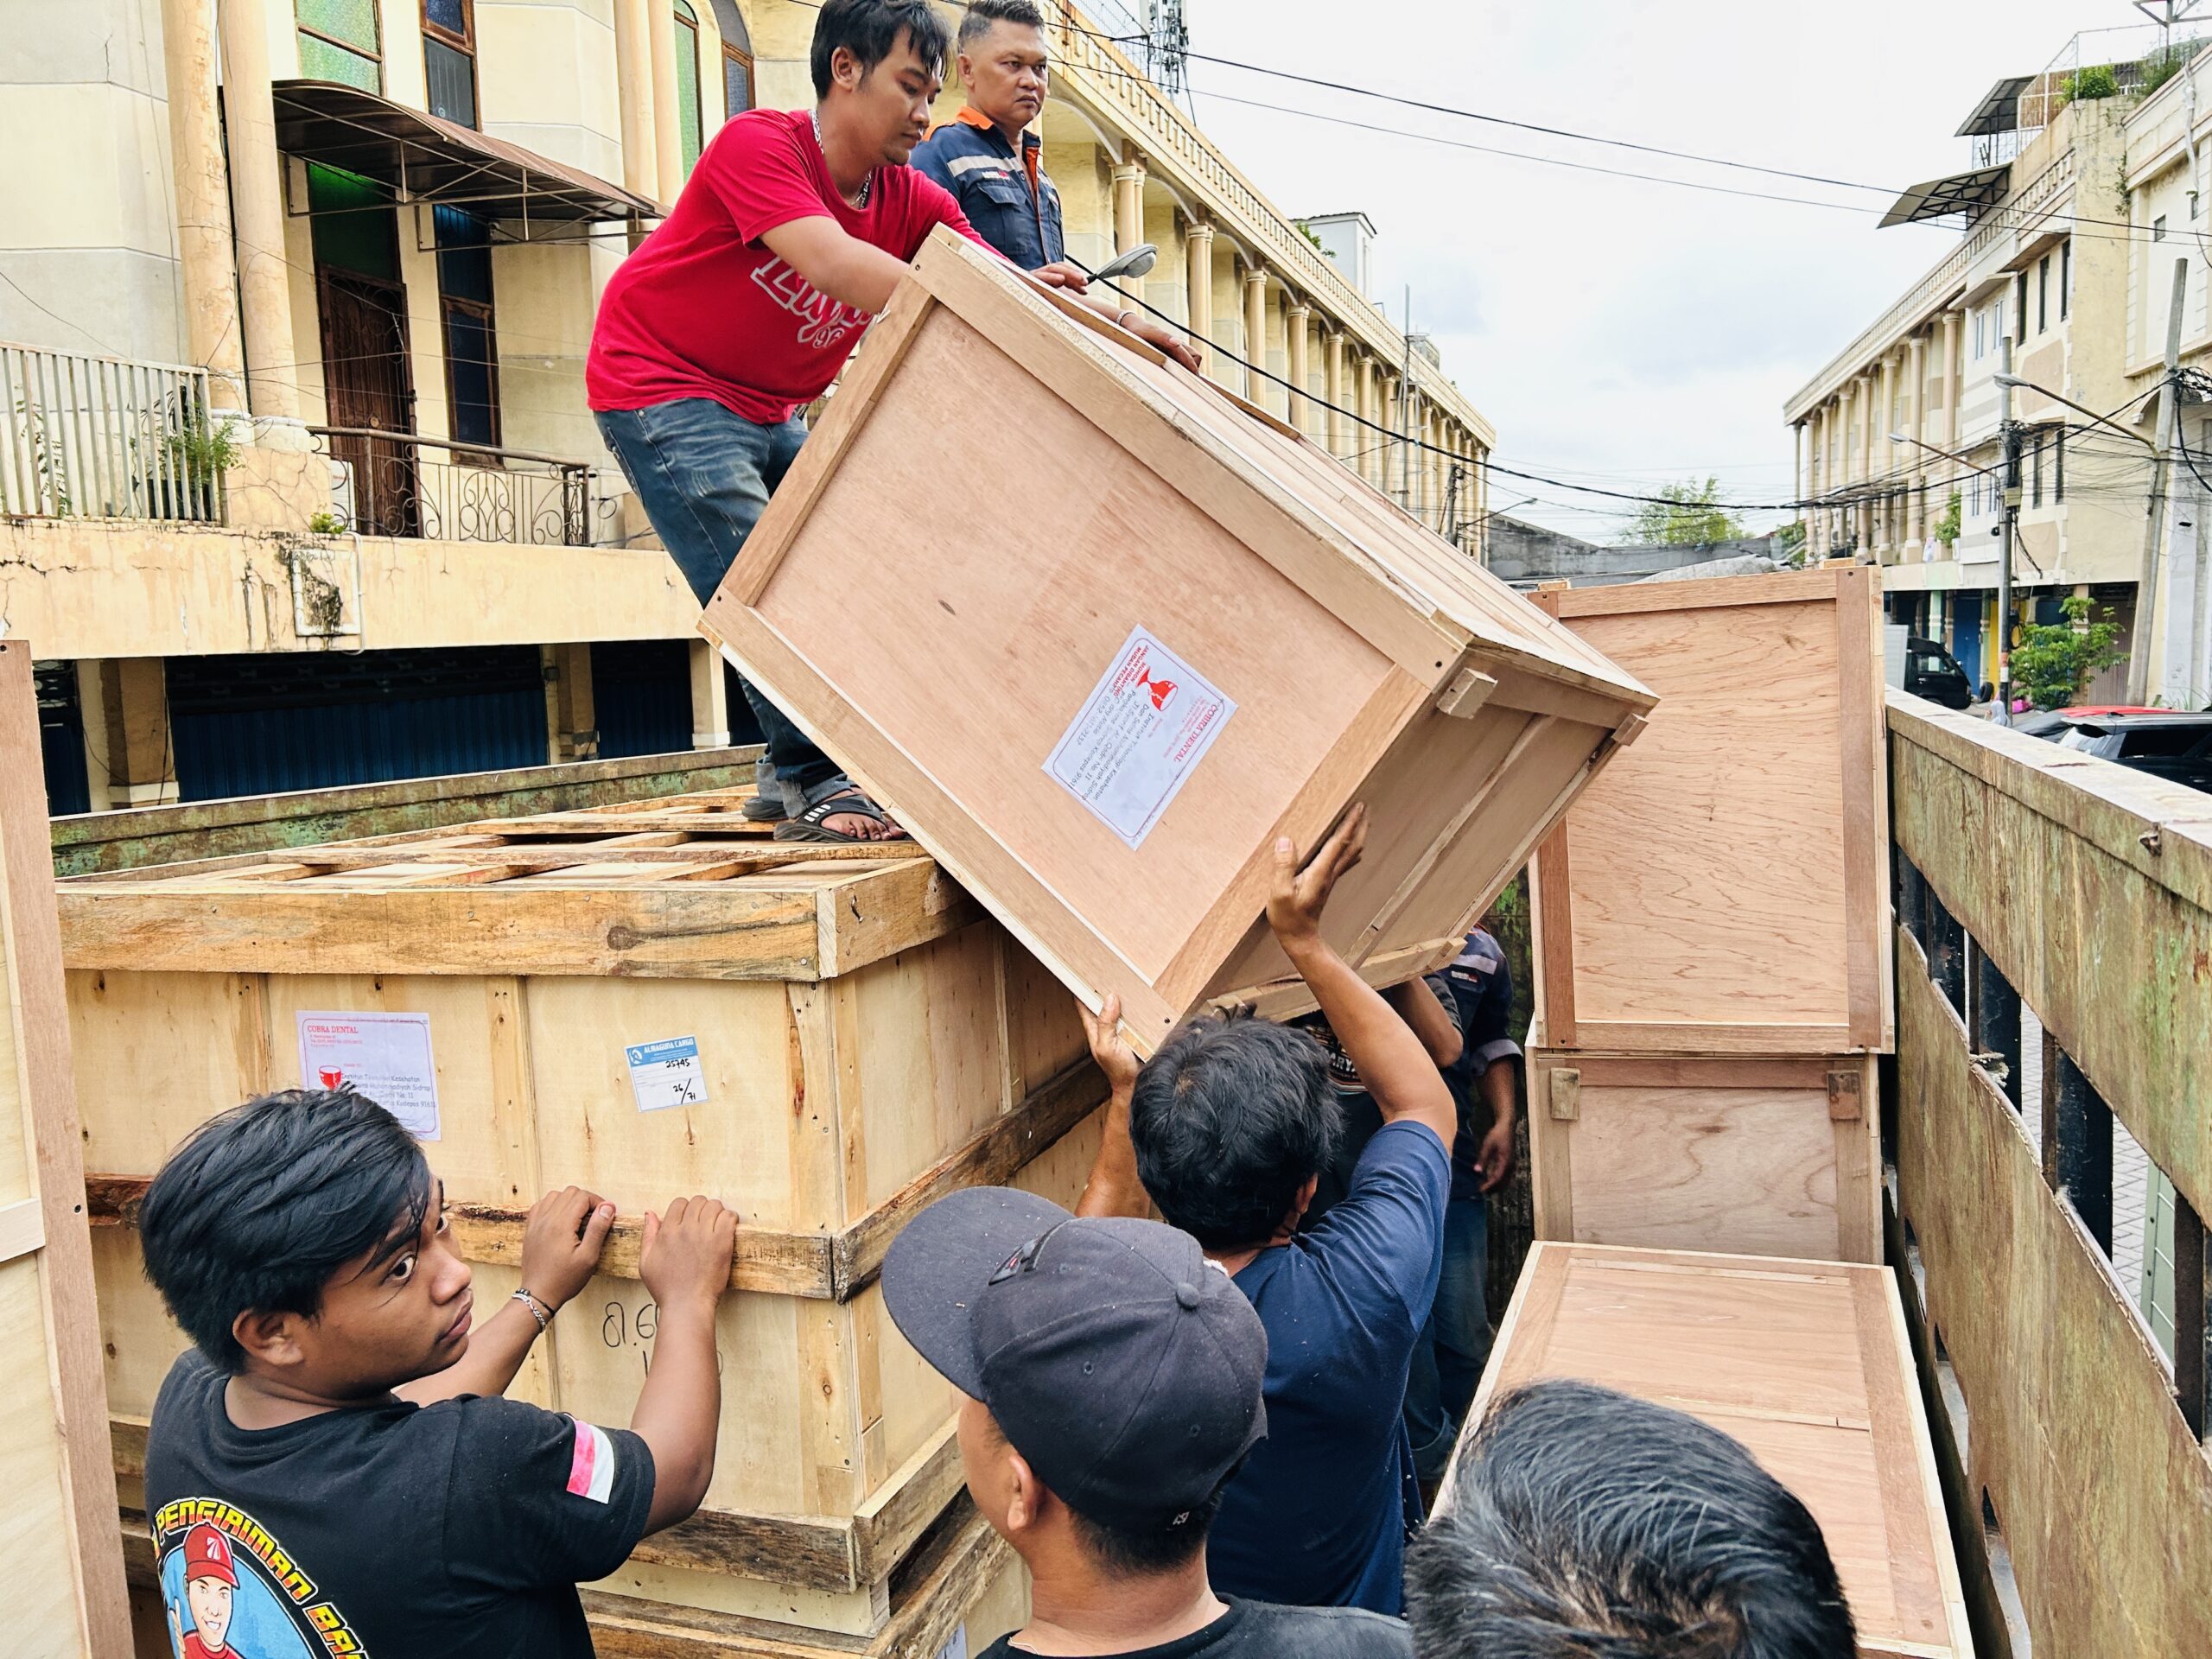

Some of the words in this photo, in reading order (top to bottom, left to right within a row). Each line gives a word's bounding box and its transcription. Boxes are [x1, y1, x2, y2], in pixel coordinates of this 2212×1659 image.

[1126, 645, 1141, 667] MUDAH
[1132, 644, 1150, 668] JANGAN
[1112, 666, 1135, 697] DIBANTING
[1129, 661, 1146, 683] MOHON
[1137, 702, 1149, 718] Dan
[1195, 702, 1218, 733] COBRA
[1173, 729, 1199, 764] DENTAL
[1092, 767, 1117, 801] Kesehatan
[156, 1499, 315, 1604] PENGIRIMAN
